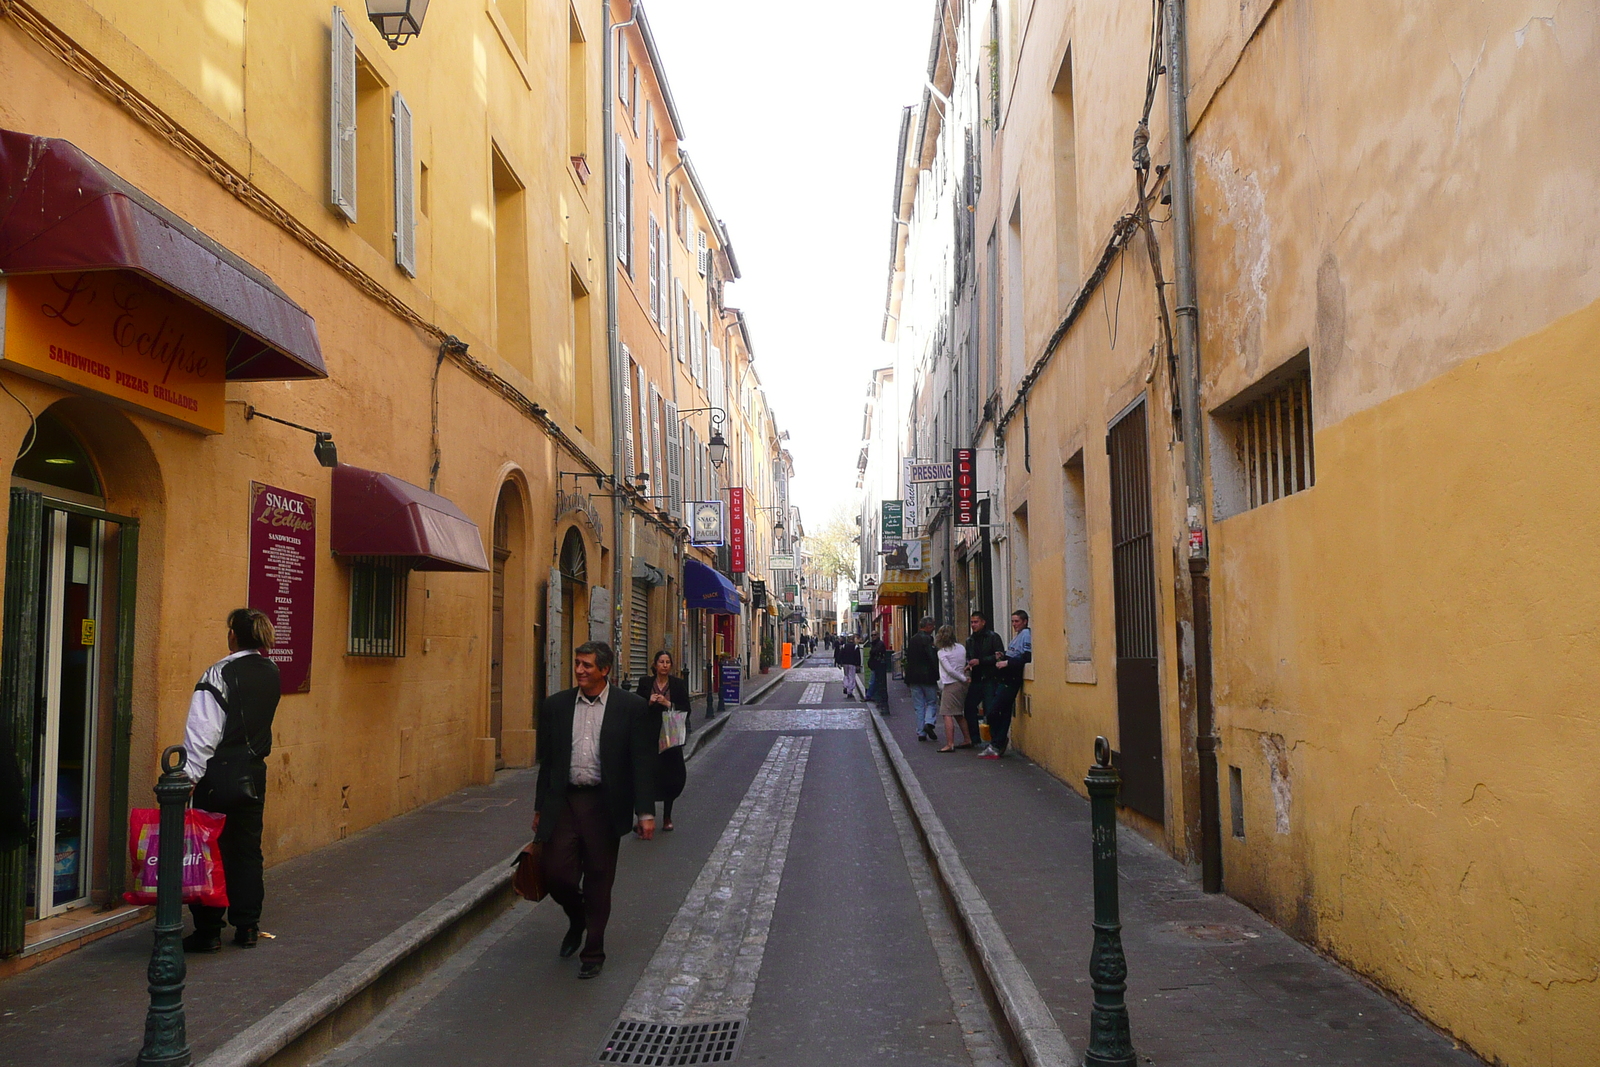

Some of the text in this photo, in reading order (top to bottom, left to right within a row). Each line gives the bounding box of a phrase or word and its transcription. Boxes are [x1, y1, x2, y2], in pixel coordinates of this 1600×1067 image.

[49, 344, 198, 412] SANDWICHS PIZZAS GRILLADES
[912, 465, 952, 481] PRESSING
[266, 492, 305, 515] SNACK
[733, 490, 741, 520] Chez
[268, 533, 301, 545] SANDWICHES
[274, 596, 293, 604] PIZZAS
